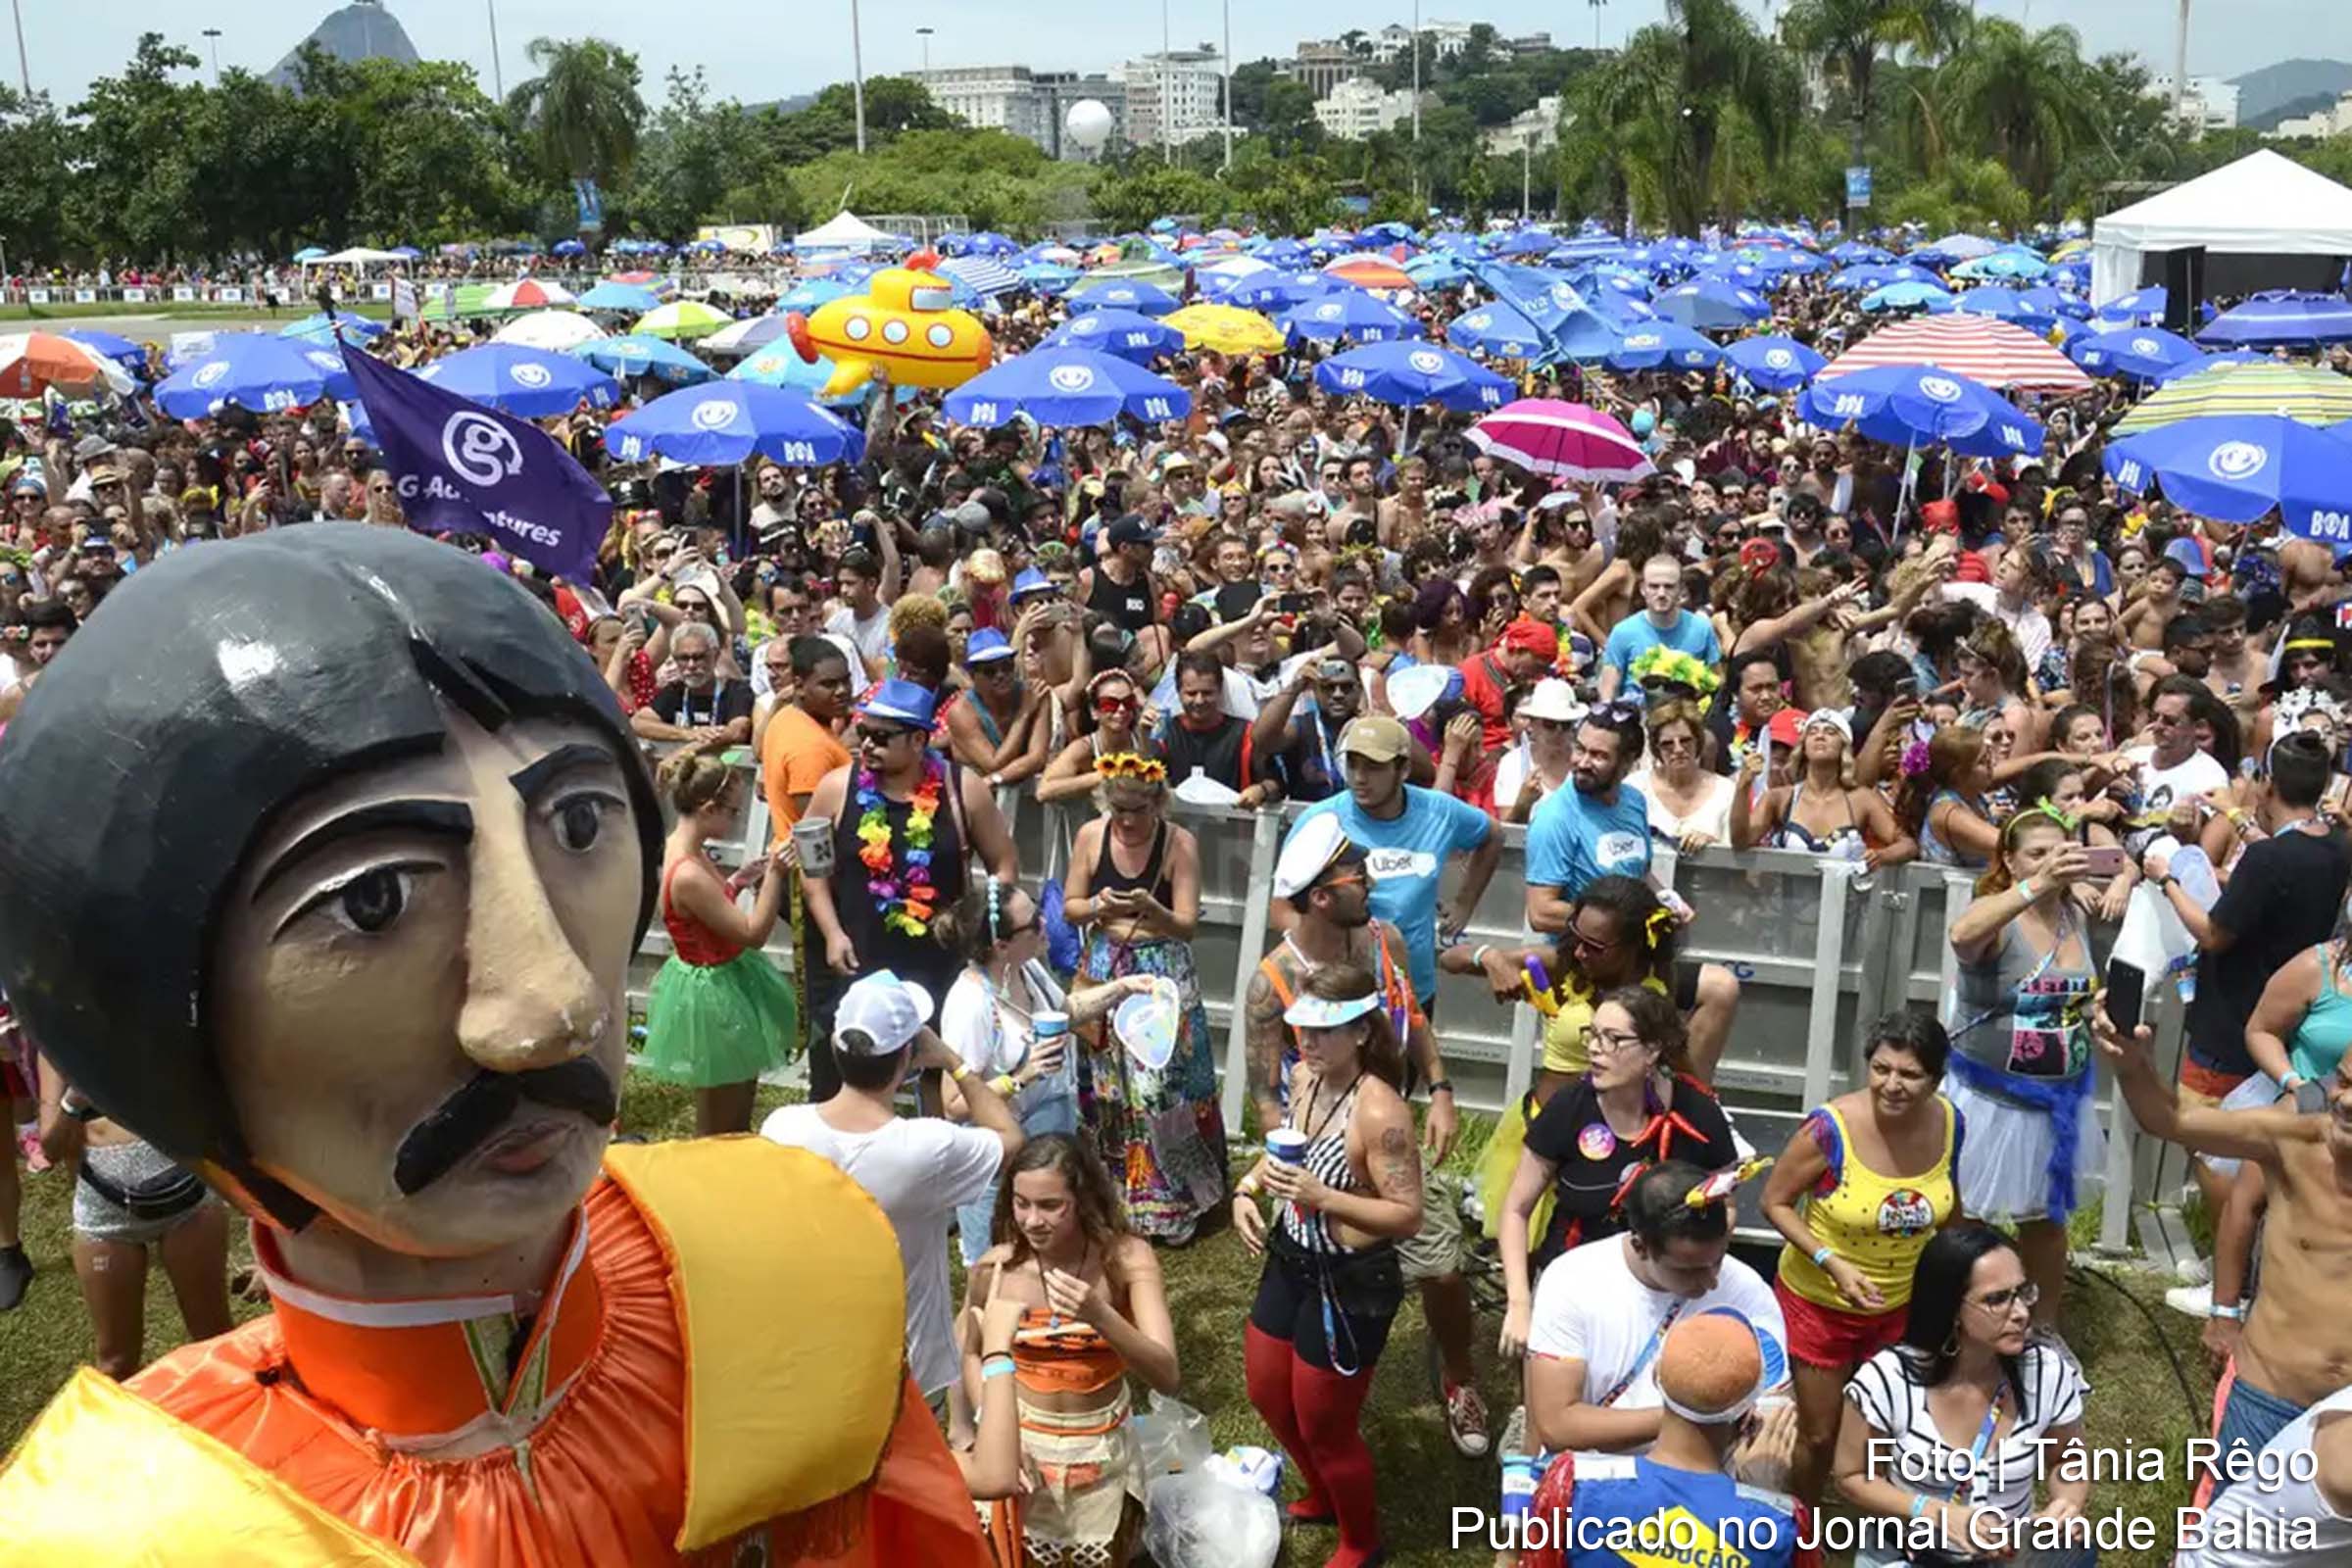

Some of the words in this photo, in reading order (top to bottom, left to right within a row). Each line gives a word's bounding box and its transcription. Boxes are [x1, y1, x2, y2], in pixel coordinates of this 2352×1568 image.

[398, 474, 418, 498] G
[2310, 510, 2350, 540] BOA
[1372, 856, 1411, 871] Uber
